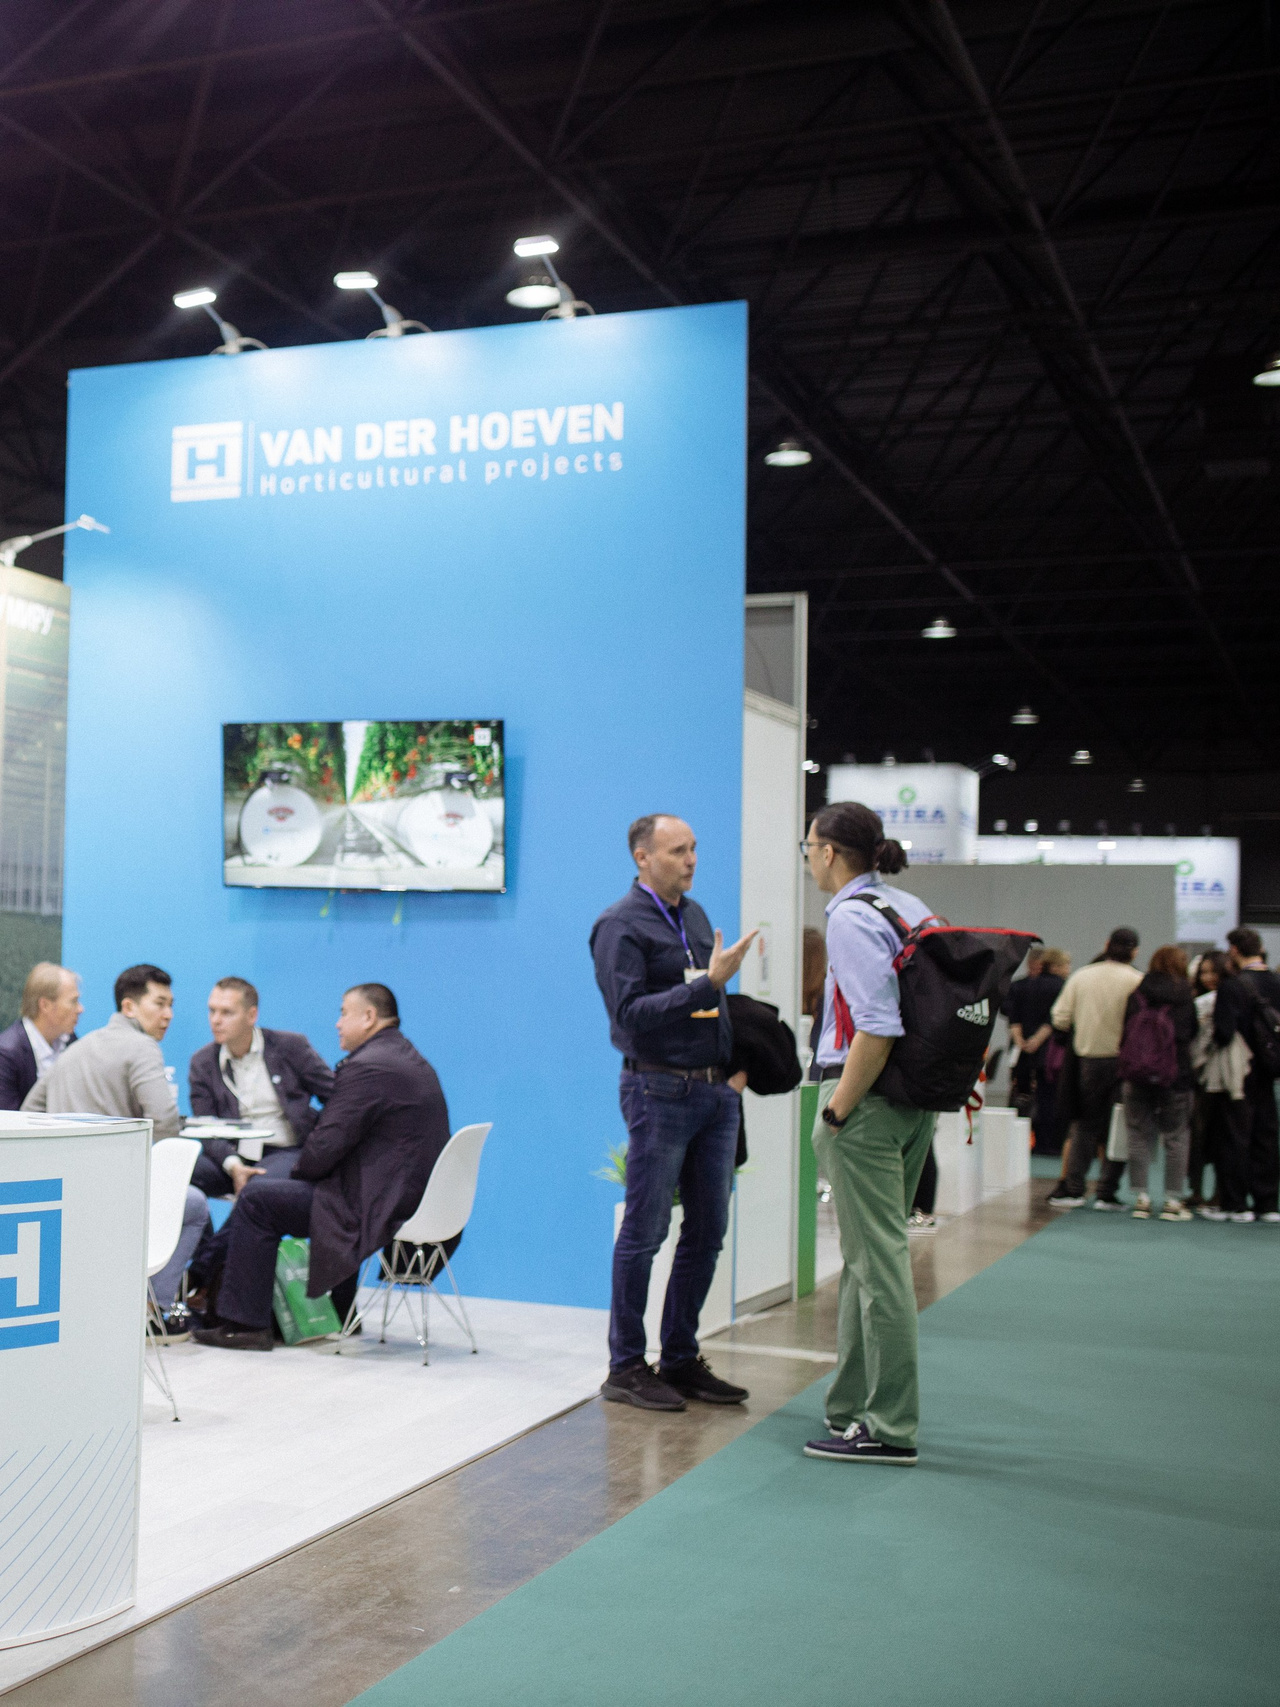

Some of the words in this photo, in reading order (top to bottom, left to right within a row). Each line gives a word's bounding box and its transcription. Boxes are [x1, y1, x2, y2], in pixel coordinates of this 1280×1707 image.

[259, 425, 342, 468] VAN
[354, 418, 436, 461] DER
[449, 402, 624, 454] HOEVEN
[260, 458, 467, 497] Horticultural
[485, 450, 623, 485] projects
[956, 1007, 990, 1026] adidas
